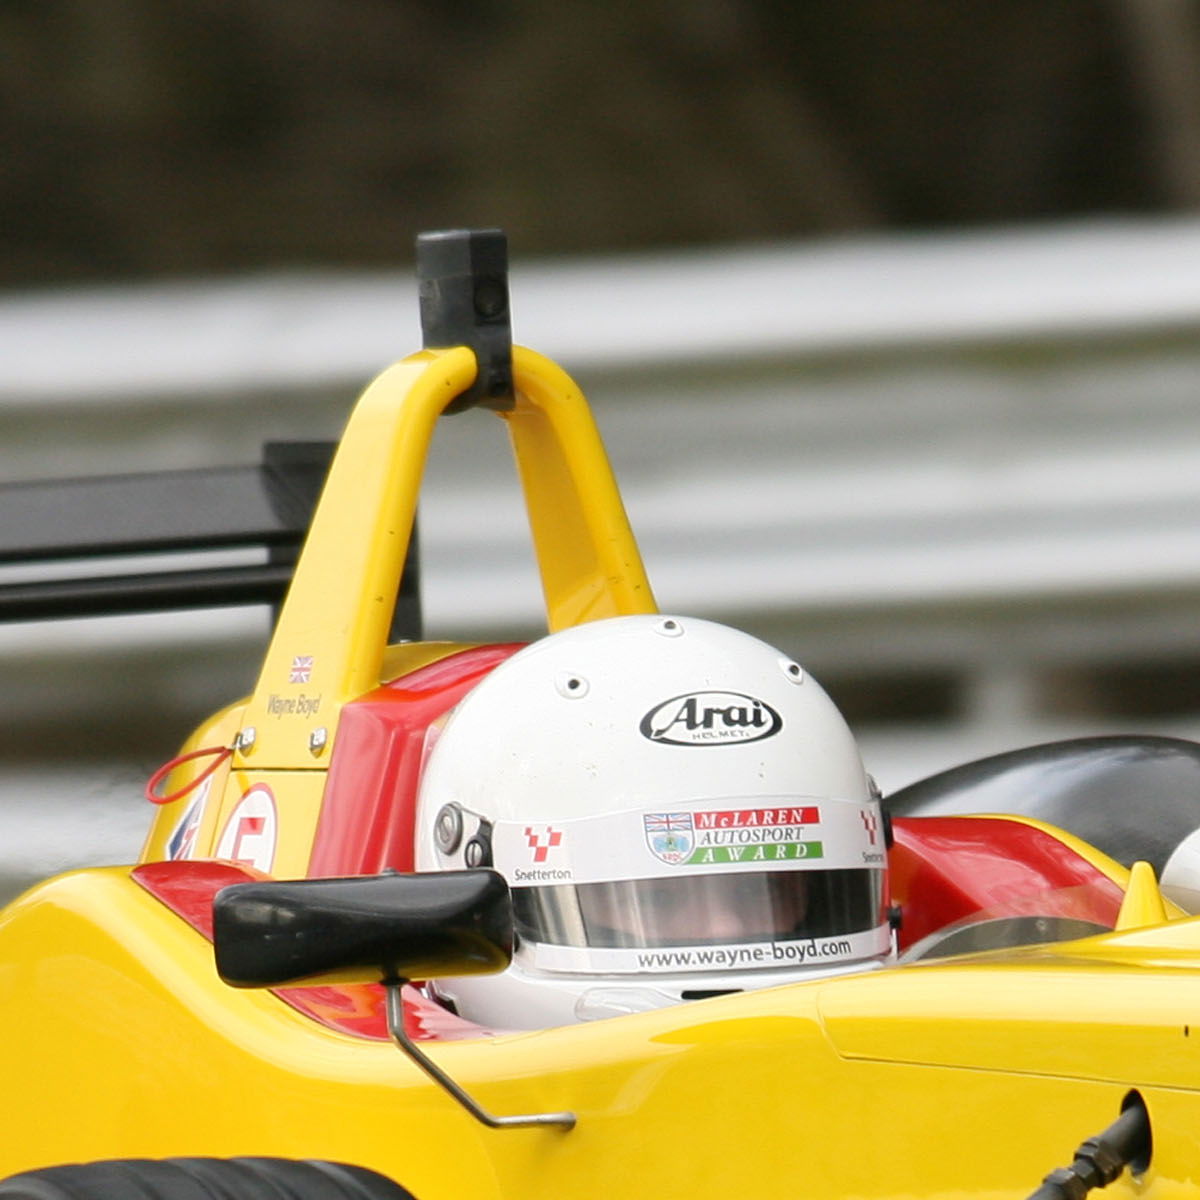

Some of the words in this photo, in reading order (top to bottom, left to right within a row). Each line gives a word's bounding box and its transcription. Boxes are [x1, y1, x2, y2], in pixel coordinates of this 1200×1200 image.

[267, 695, 296, 720] Wayne
[296, 693, 322, 719] Boyd
[653, 698, 768, 736] Arai
[700, 809, 804, 828] McLAREN
[701, 827, 804, 845] AUTOSPORT
[702, 844, 808, 862] AWARD
[514, 868, 572, 881] Snetterton
[638, 938, 852, 968] www.wayne-boyd.com
